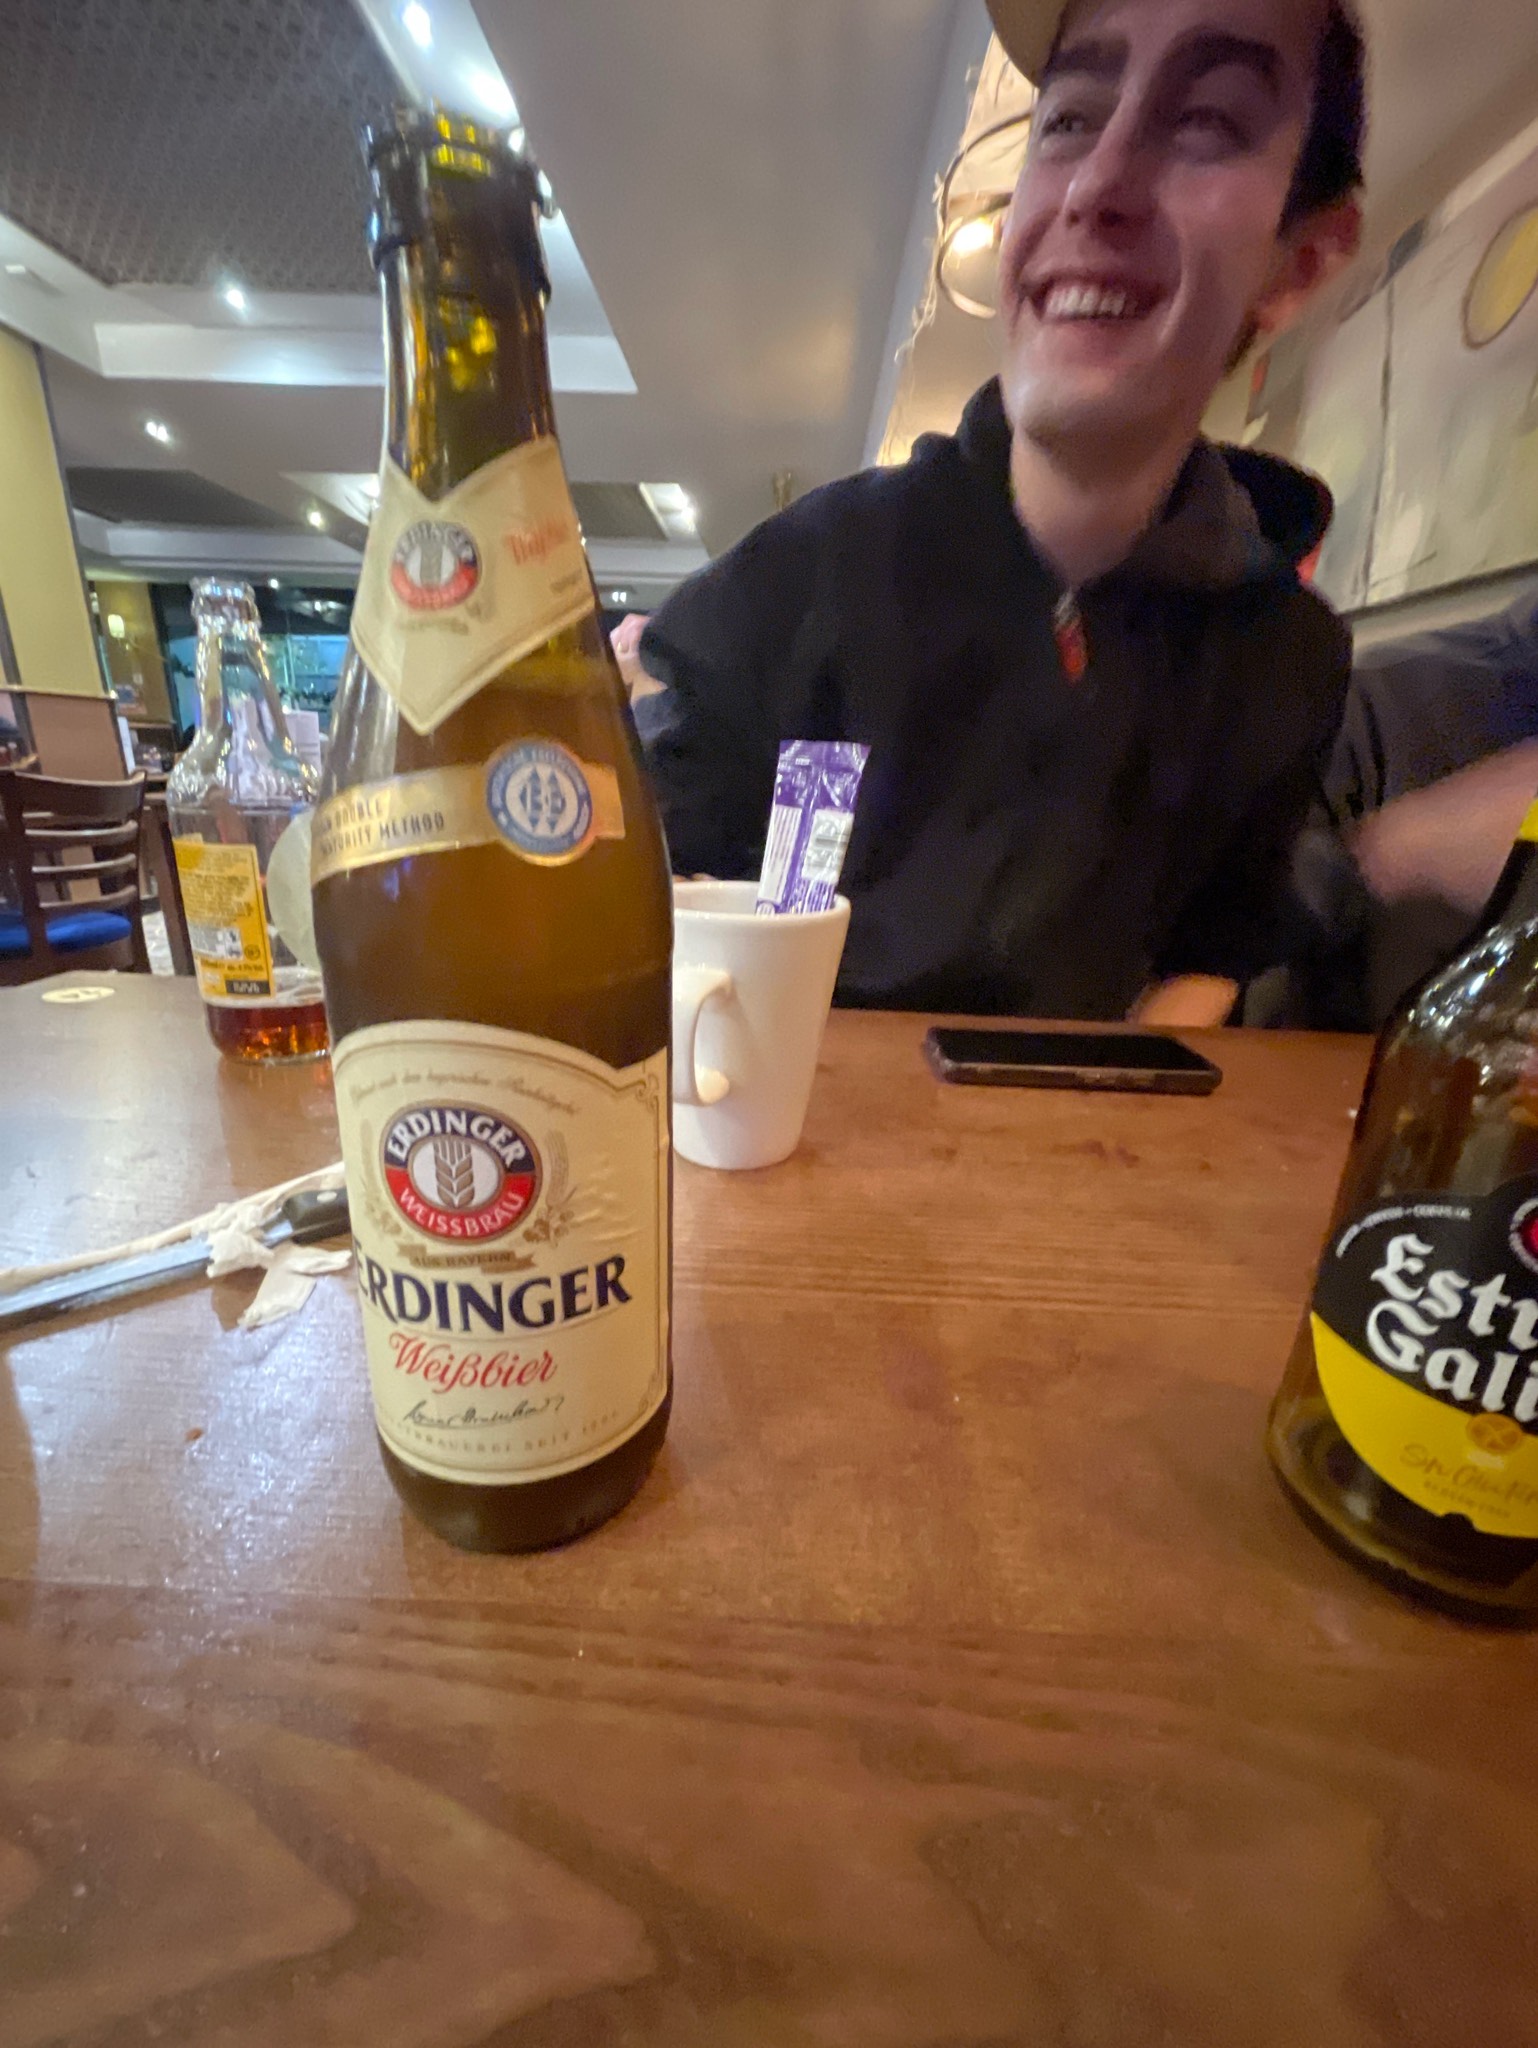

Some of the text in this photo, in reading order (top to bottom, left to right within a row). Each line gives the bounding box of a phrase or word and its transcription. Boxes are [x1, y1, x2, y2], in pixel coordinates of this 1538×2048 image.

[379, 811, 445, 840] METHOD
[387, 1109, 526, 1169] ERDINGER
[389, 1331, 557, 1395] Weißbier
